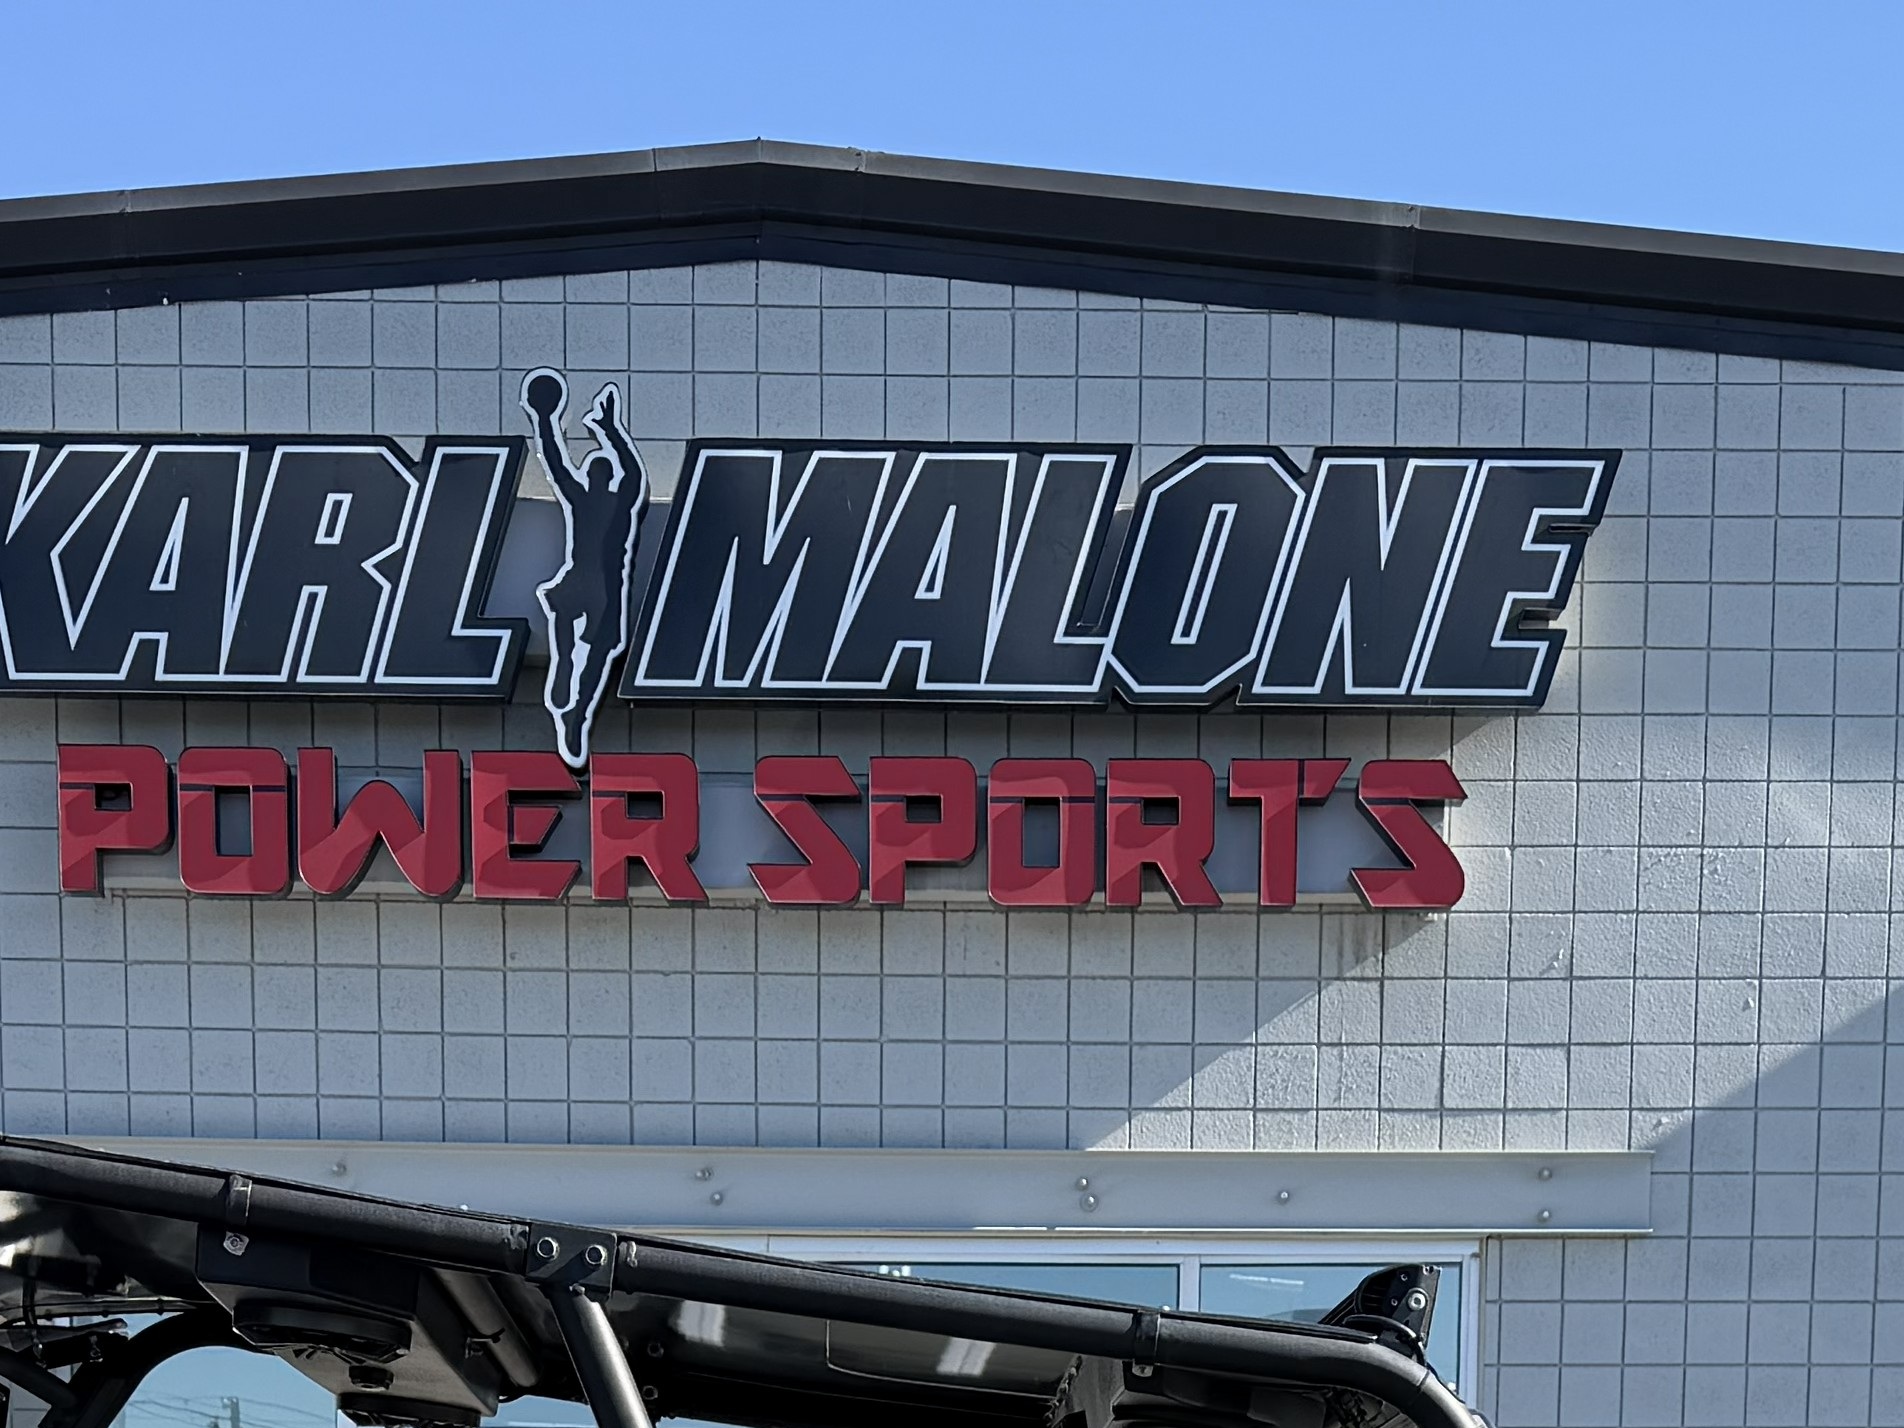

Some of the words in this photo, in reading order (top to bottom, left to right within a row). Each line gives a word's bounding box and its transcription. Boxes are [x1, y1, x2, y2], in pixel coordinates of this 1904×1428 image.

[626, 442, 1618, 702] MALONE
[57, 743, 709, 902] POWER
[746, 753, 1471, 912] SPORTS
